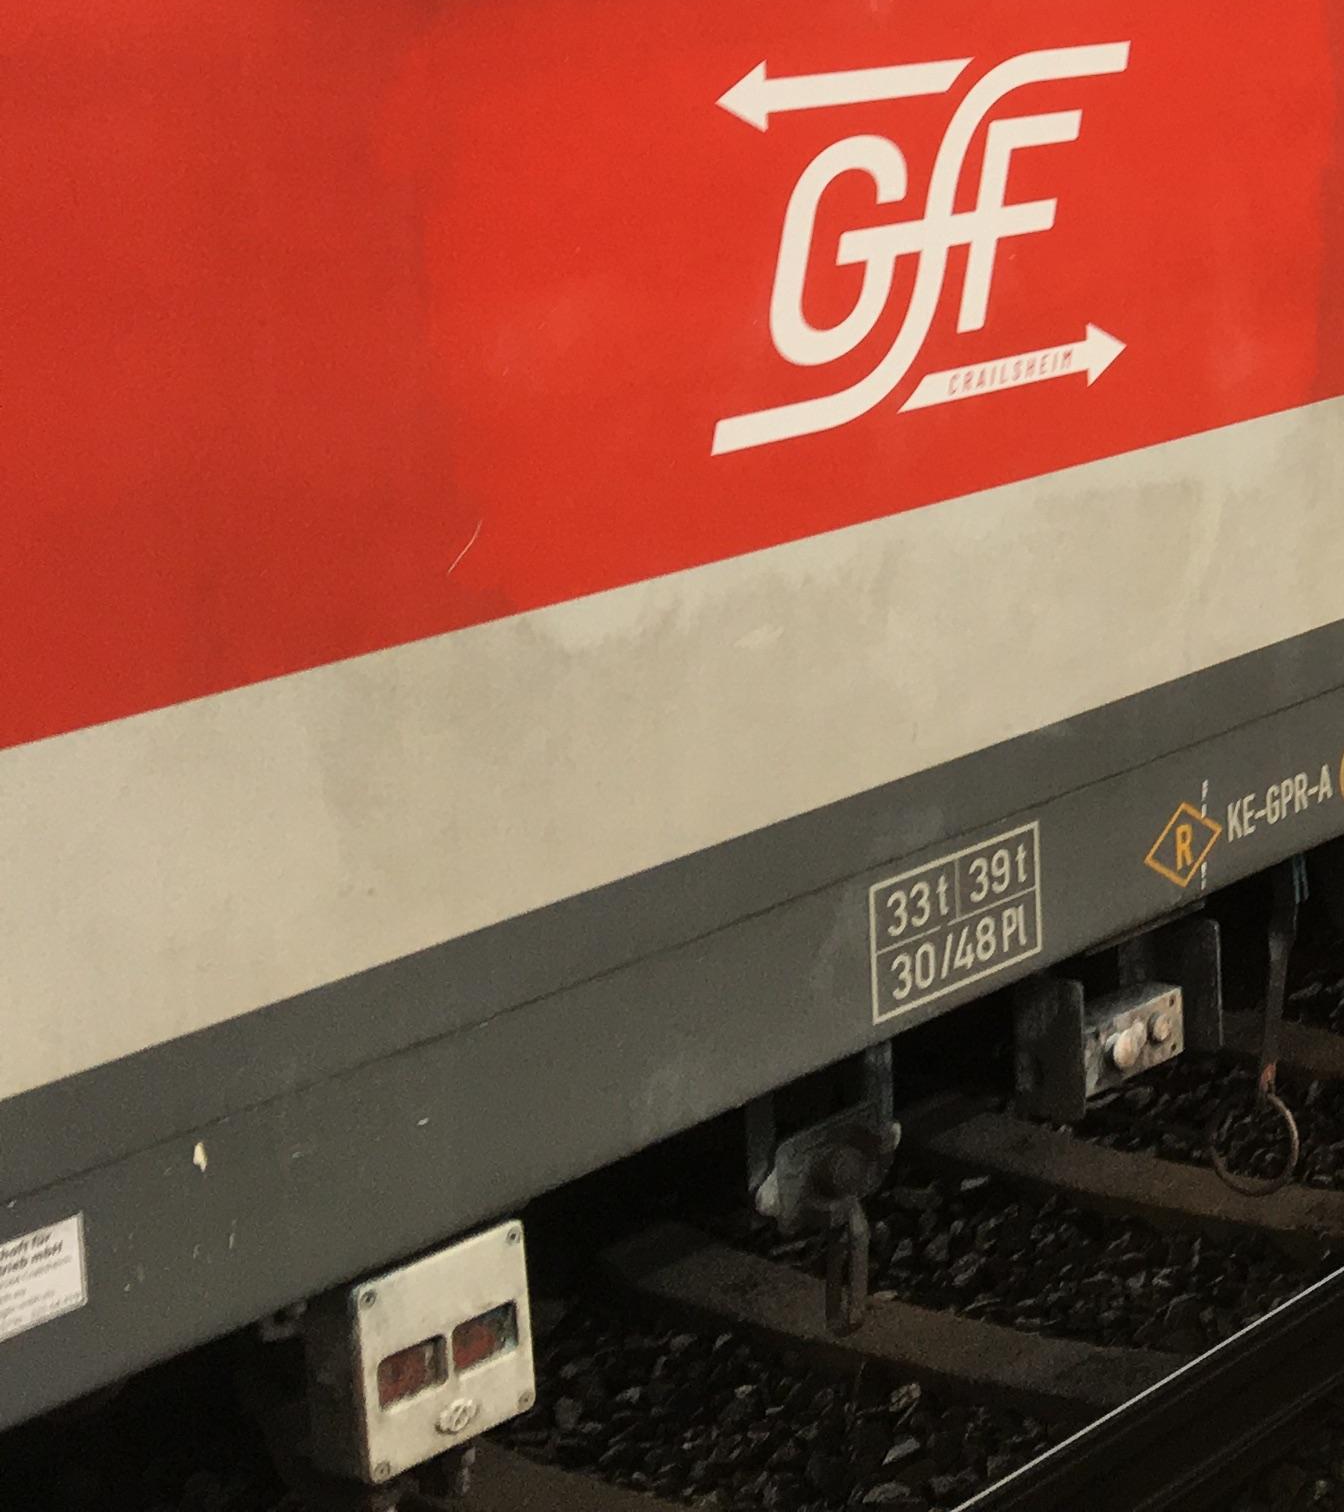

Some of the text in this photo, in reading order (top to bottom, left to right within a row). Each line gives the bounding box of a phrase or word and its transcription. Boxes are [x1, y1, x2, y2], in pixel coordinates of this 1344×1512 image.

[948, 349, 1074, 396] CRAILSHEIM
[1227, 763, 1333, 843] KE-GPR-A
[1176, 824, 1194, 871] R
